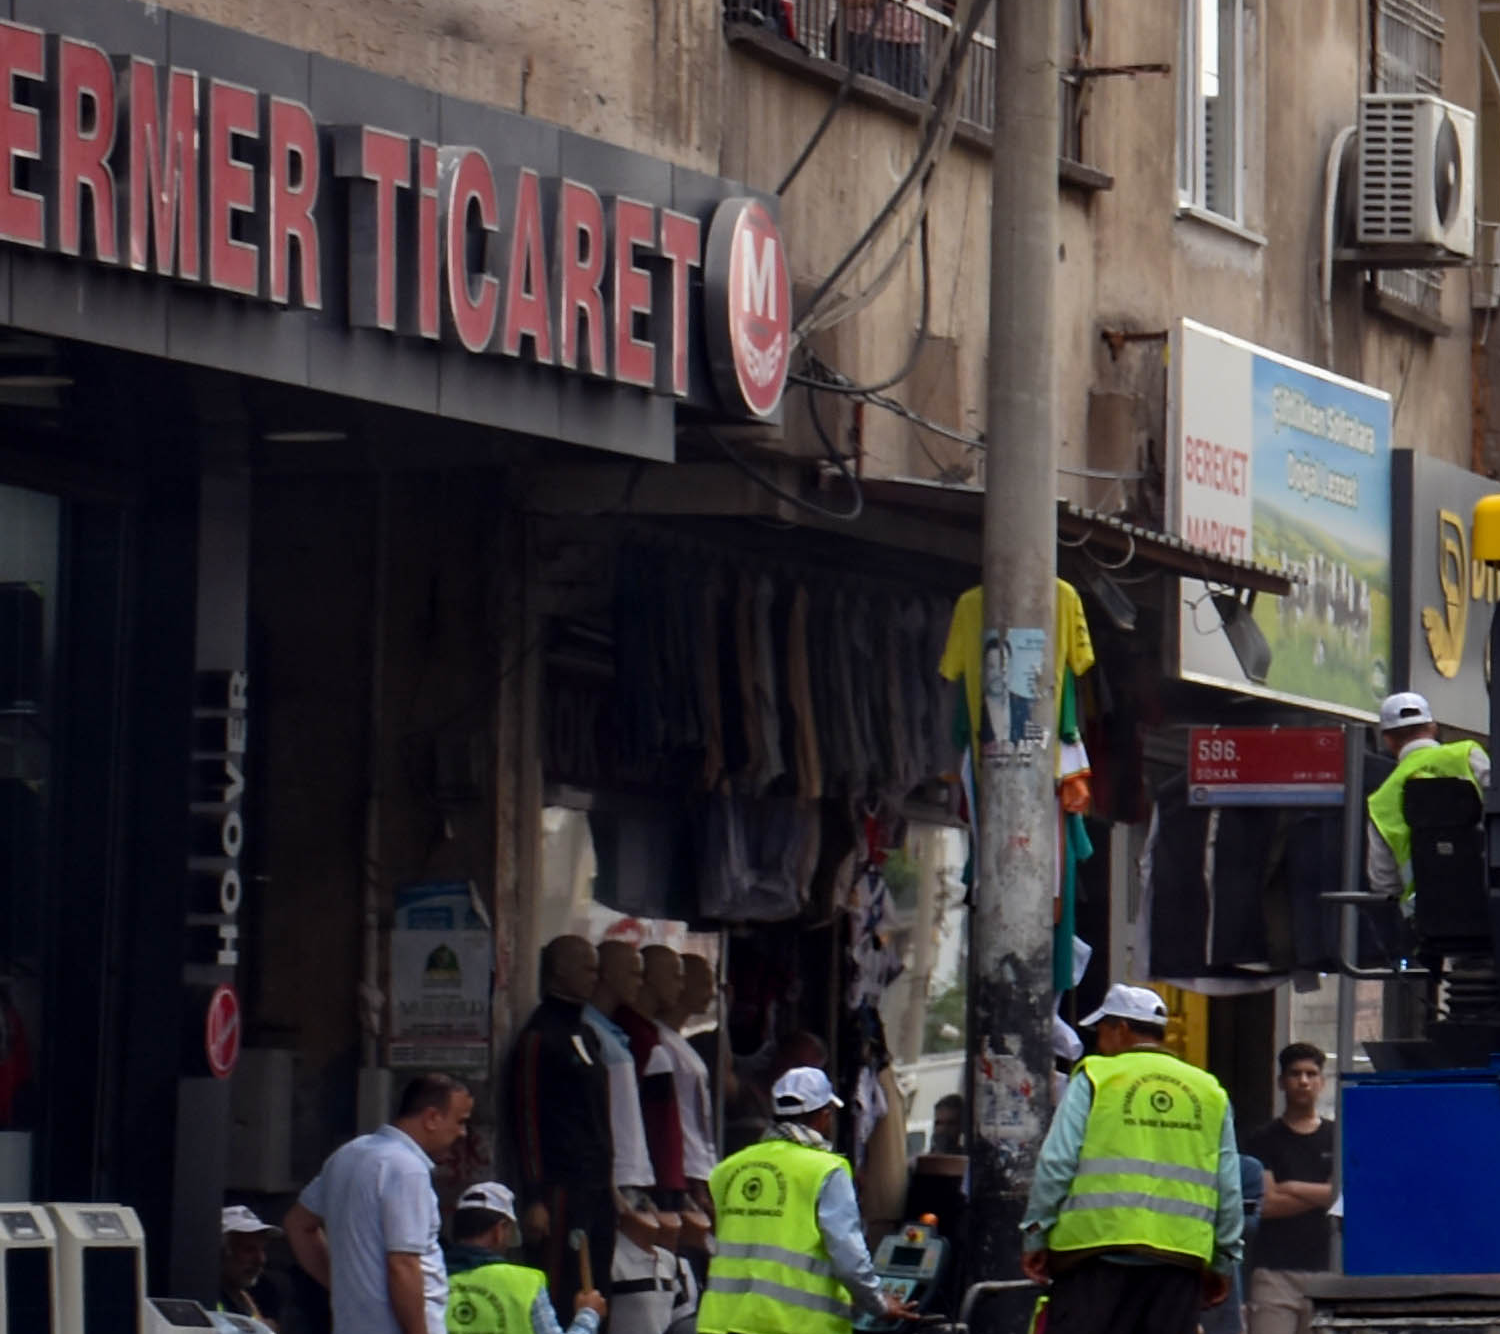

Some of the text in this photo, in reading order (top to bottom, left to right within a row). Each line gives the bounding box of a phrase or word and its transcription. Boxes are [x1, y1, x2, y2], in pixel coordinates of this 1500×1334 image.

[1186, 433, 1248, 497] BEREKET
[1186, 514, 1247, 561] MARKET
[216, 670, 247, 966] HOOVER
